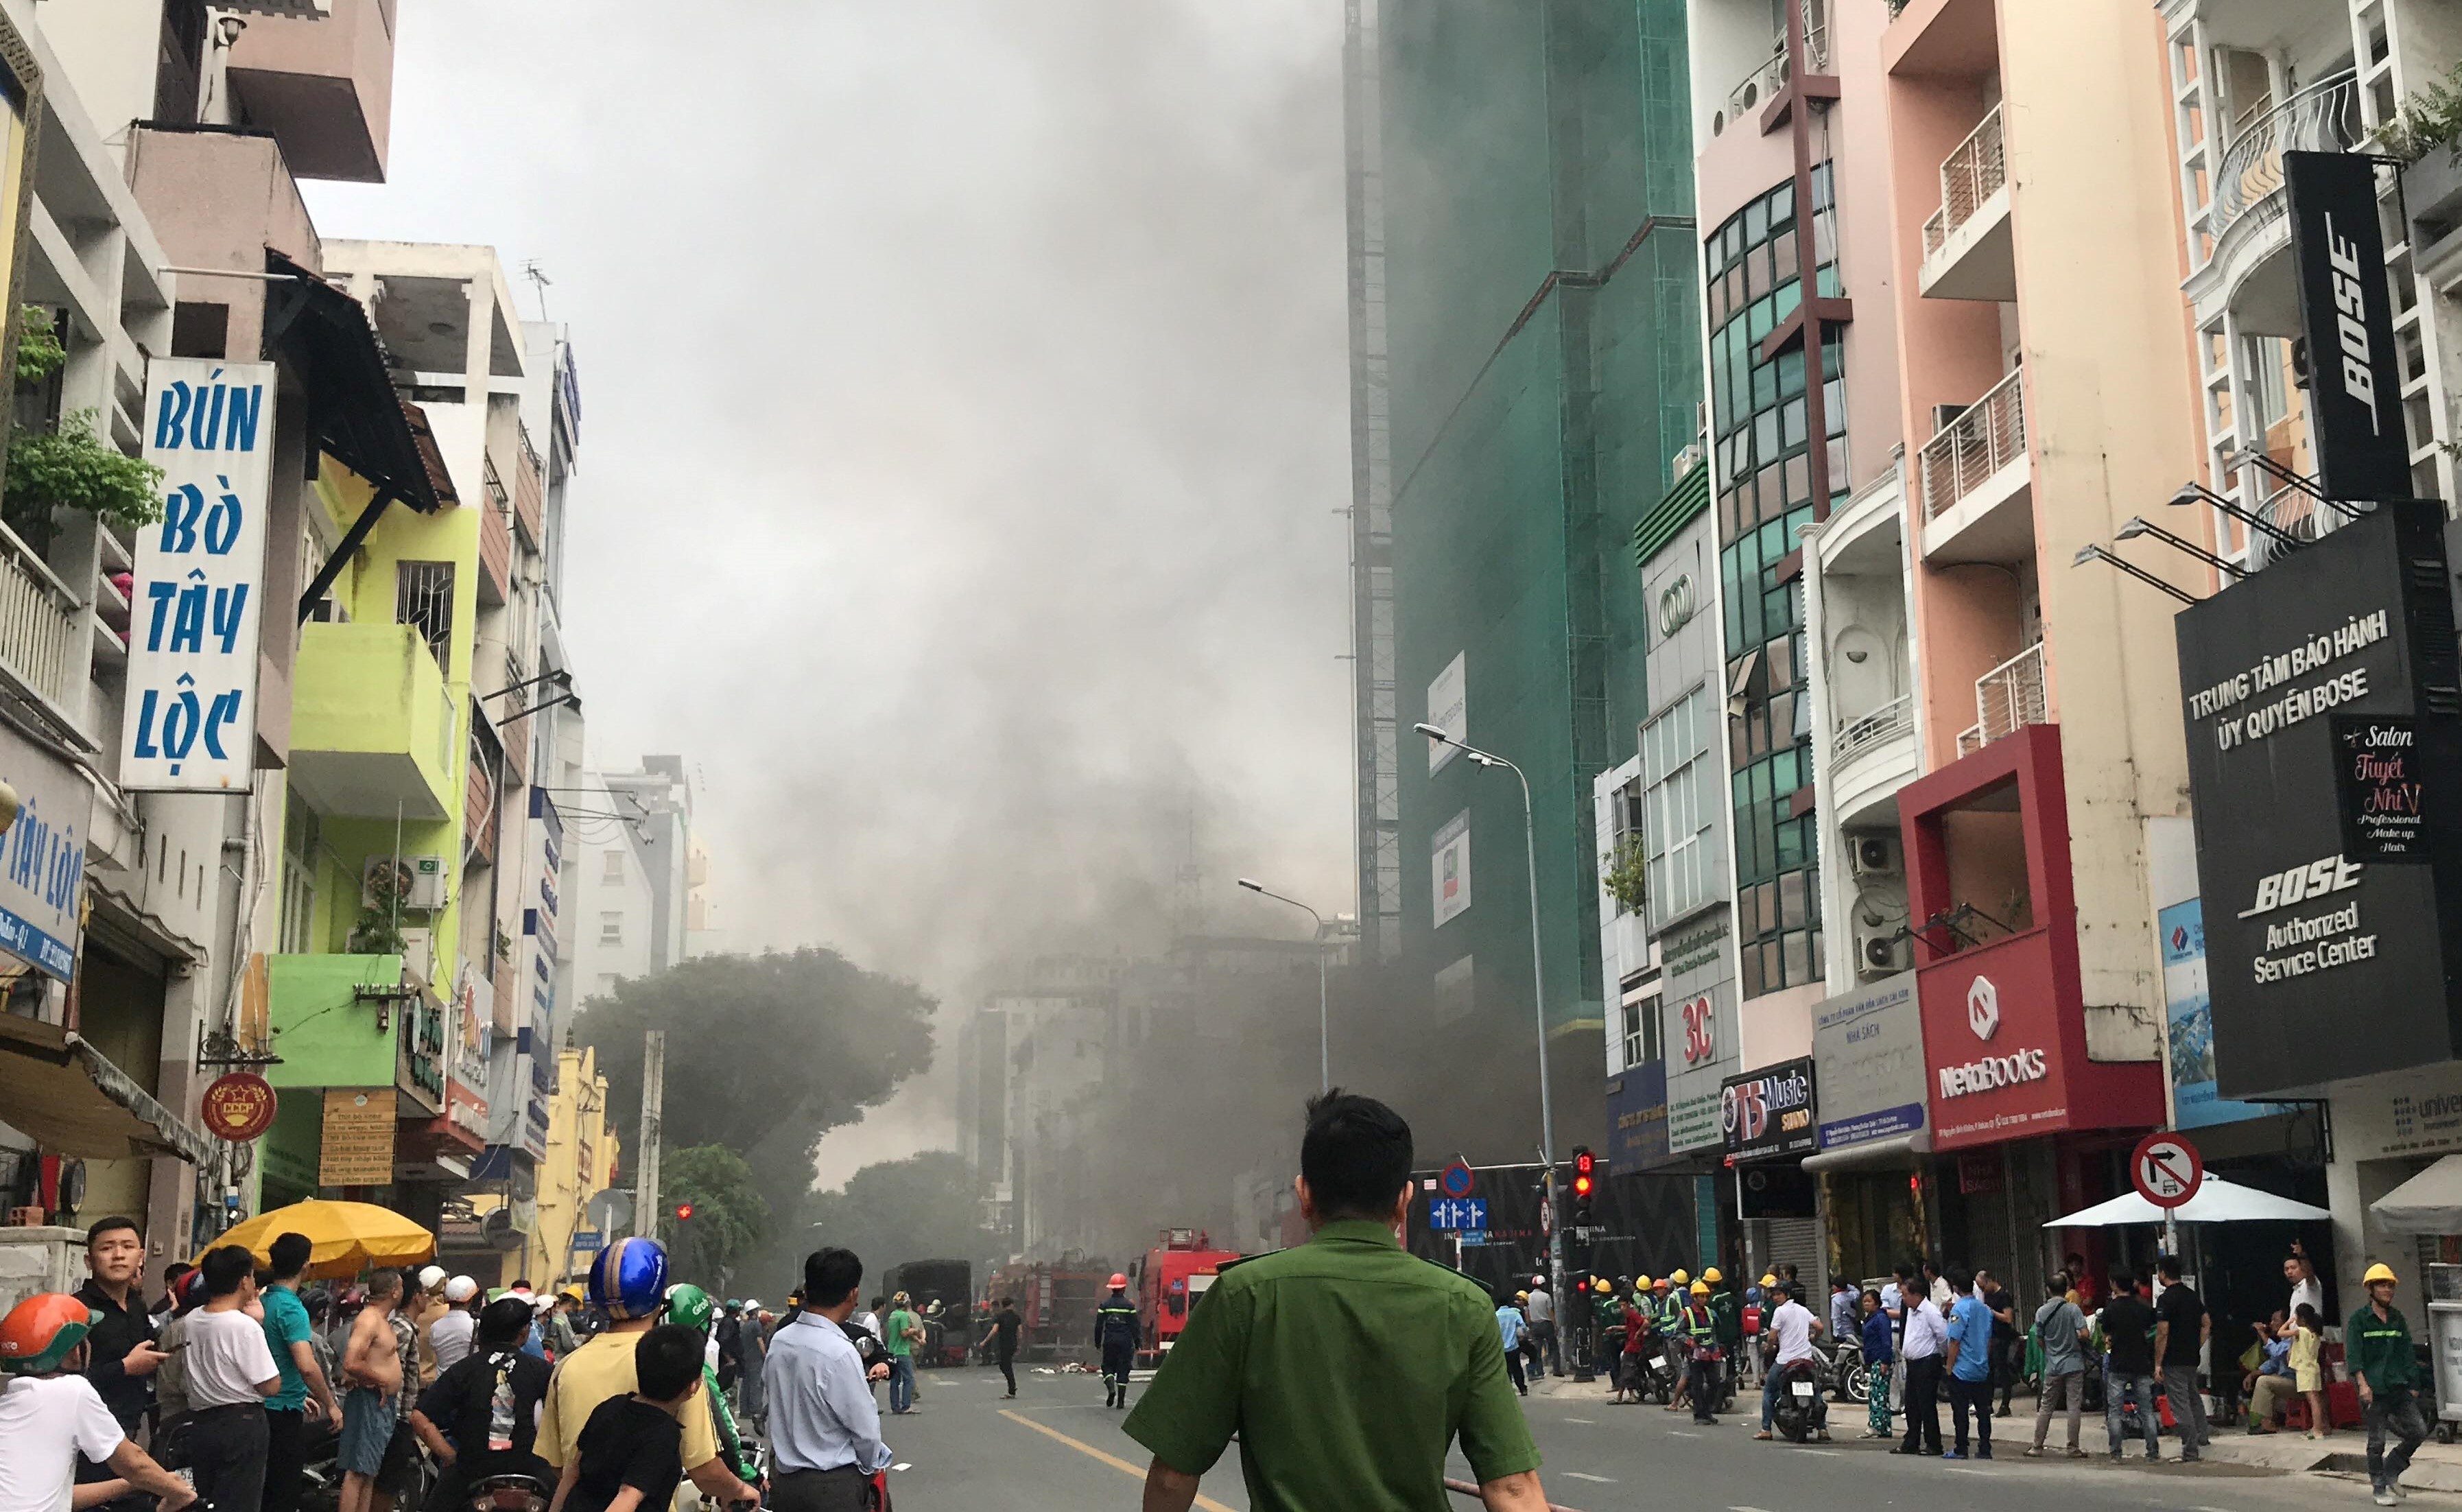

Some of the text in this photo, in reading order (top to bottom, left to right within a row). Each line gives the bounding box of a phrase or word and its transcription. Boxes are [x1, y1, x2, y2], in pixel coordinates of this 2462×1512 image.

[2325, 211, 2378, 436] BOSE
[154, 368, 263, 451] BÚN
[159, 475, 243, 556] BÒ
[147, 568, 250, 654] TÂY
[2190, 609, 2388, 720] TRUNG TÂM BẢO HÀNH
[134, 672, 242, 777] LỘC
[2218, 716, 2242, 751] ỦY
[2314, 668, 2367, 710] BOSE
[2365, 724, 2413, 747] Salon
[2355, 753, 2406, 785] Tuyết
[2357, 814, 2421, 825] Professional
[2380, 842, 2406, 851] Hair
[2237, 854, 2363, 919] BOSE
[2266, 901, 2358, 951] Authorized
[2254, 932, 2377, 984] Service Center
[1681, 996, 1712, 1063] 3C
[1764, 1070, 1807, 1111] Music
[1939, 1048, 2047, 1099] NetaBooks
[1580, 1157, 1591, 1170] 13
[692, 1298, 709, 1315] Grab
